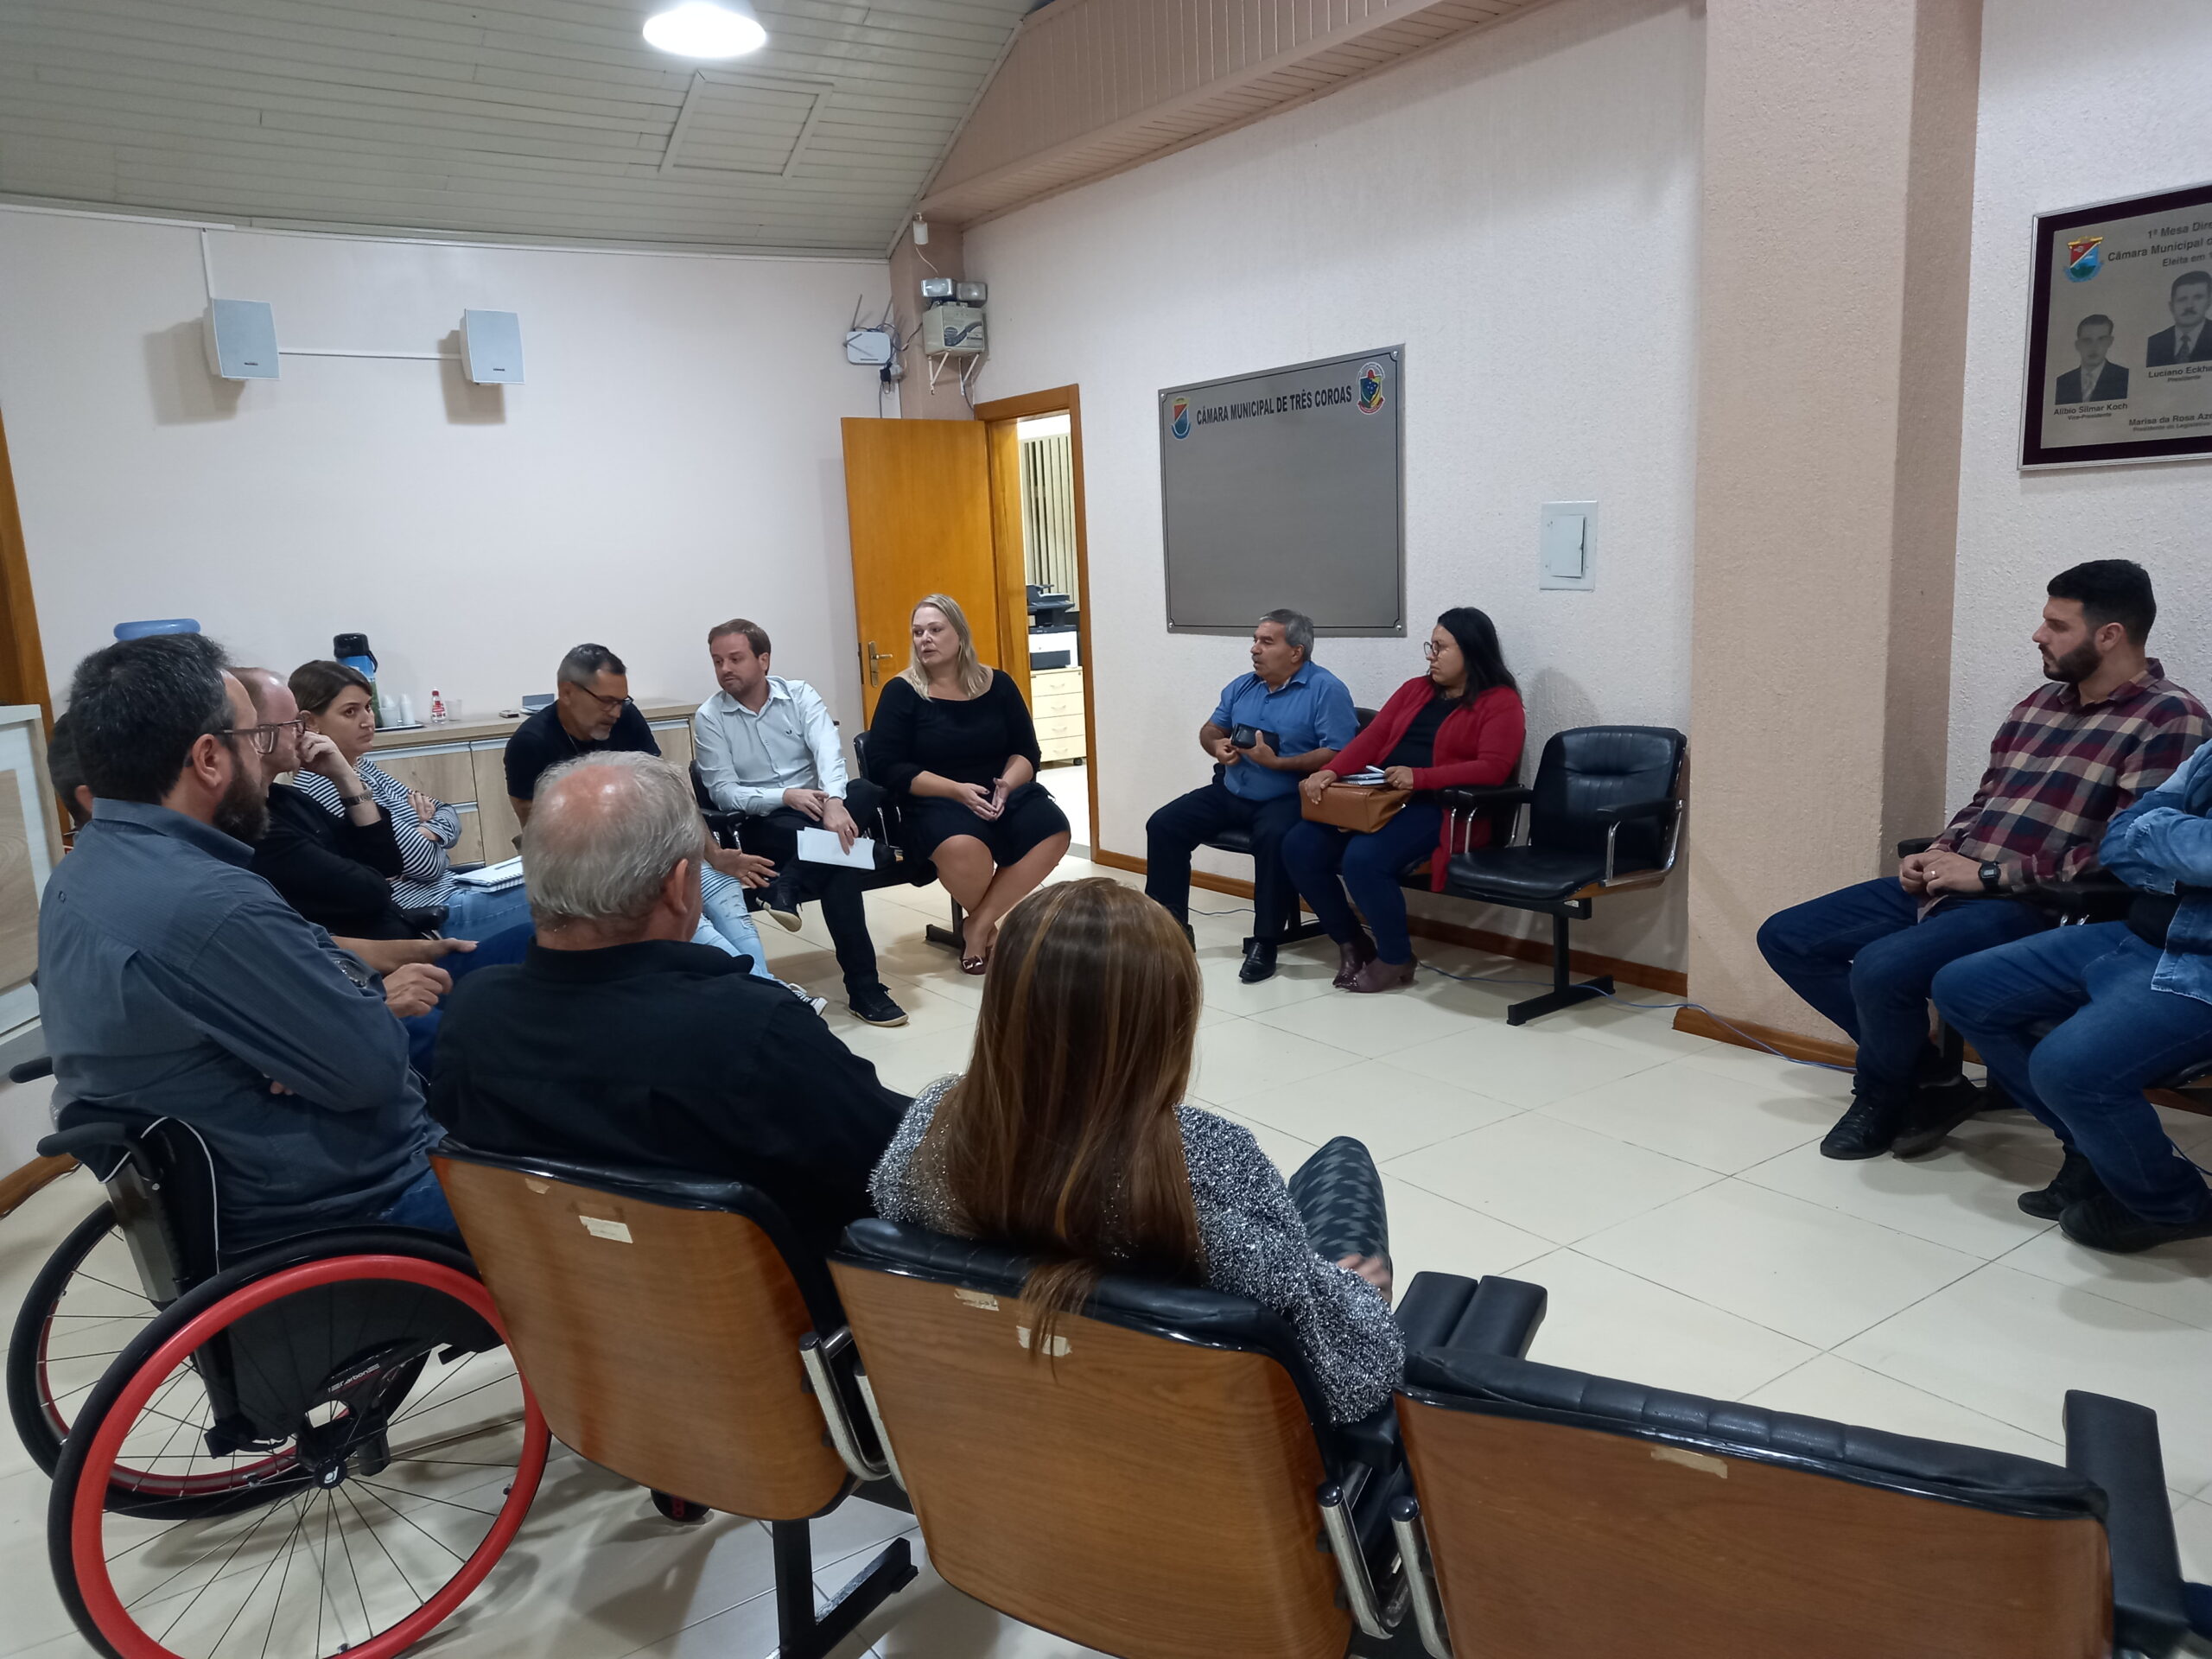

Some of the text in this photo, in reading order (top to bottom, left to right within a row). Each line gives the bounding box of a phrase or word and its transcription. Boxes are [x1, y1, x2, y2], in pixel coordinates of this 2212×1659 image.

[2161, 226, 2190, 237] Mesa
[2108, 248, 2147, 261] Câmara
[2151, 238, 2203, 255] Municipal
[2163, 257, 2188, 267] Eleita
[2190, 254, 2205, 263] em
[2148, 368, 2183, 378] Luciano
[1197, 385, 1352, 425] CÂMARA MUNICIPAL DE TRÊS COROAS
[2079, 405, 2104, 414] Silmar
